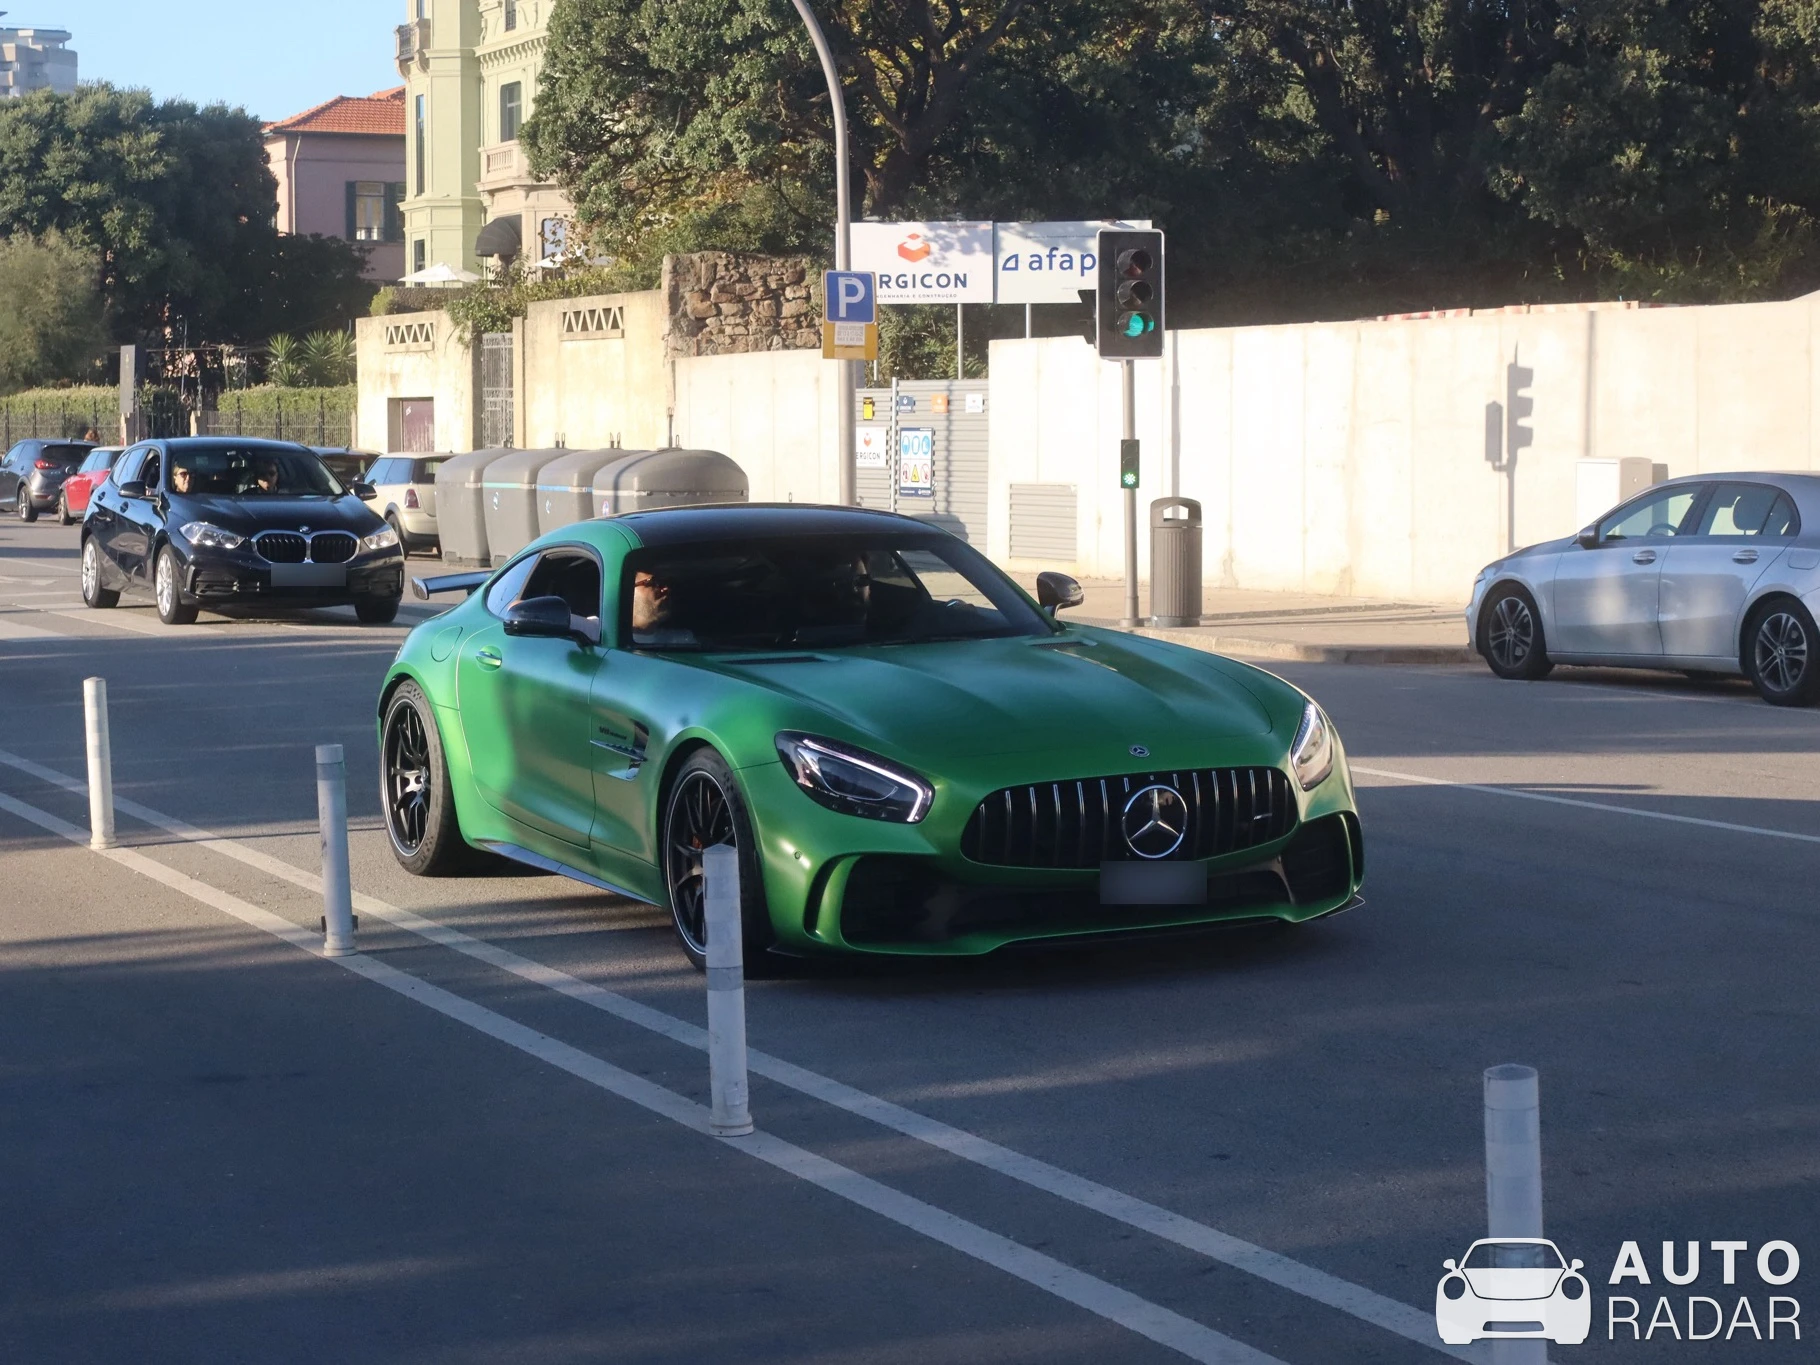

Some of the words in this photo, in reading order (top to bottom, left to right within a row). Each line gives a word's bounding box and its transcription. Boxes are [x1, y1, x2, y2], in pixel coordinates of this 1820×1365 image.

[1028, 246, 1097, 277] afap
[879, 273, 967, 289] RGICON
[838, 277, 866, 318] P
